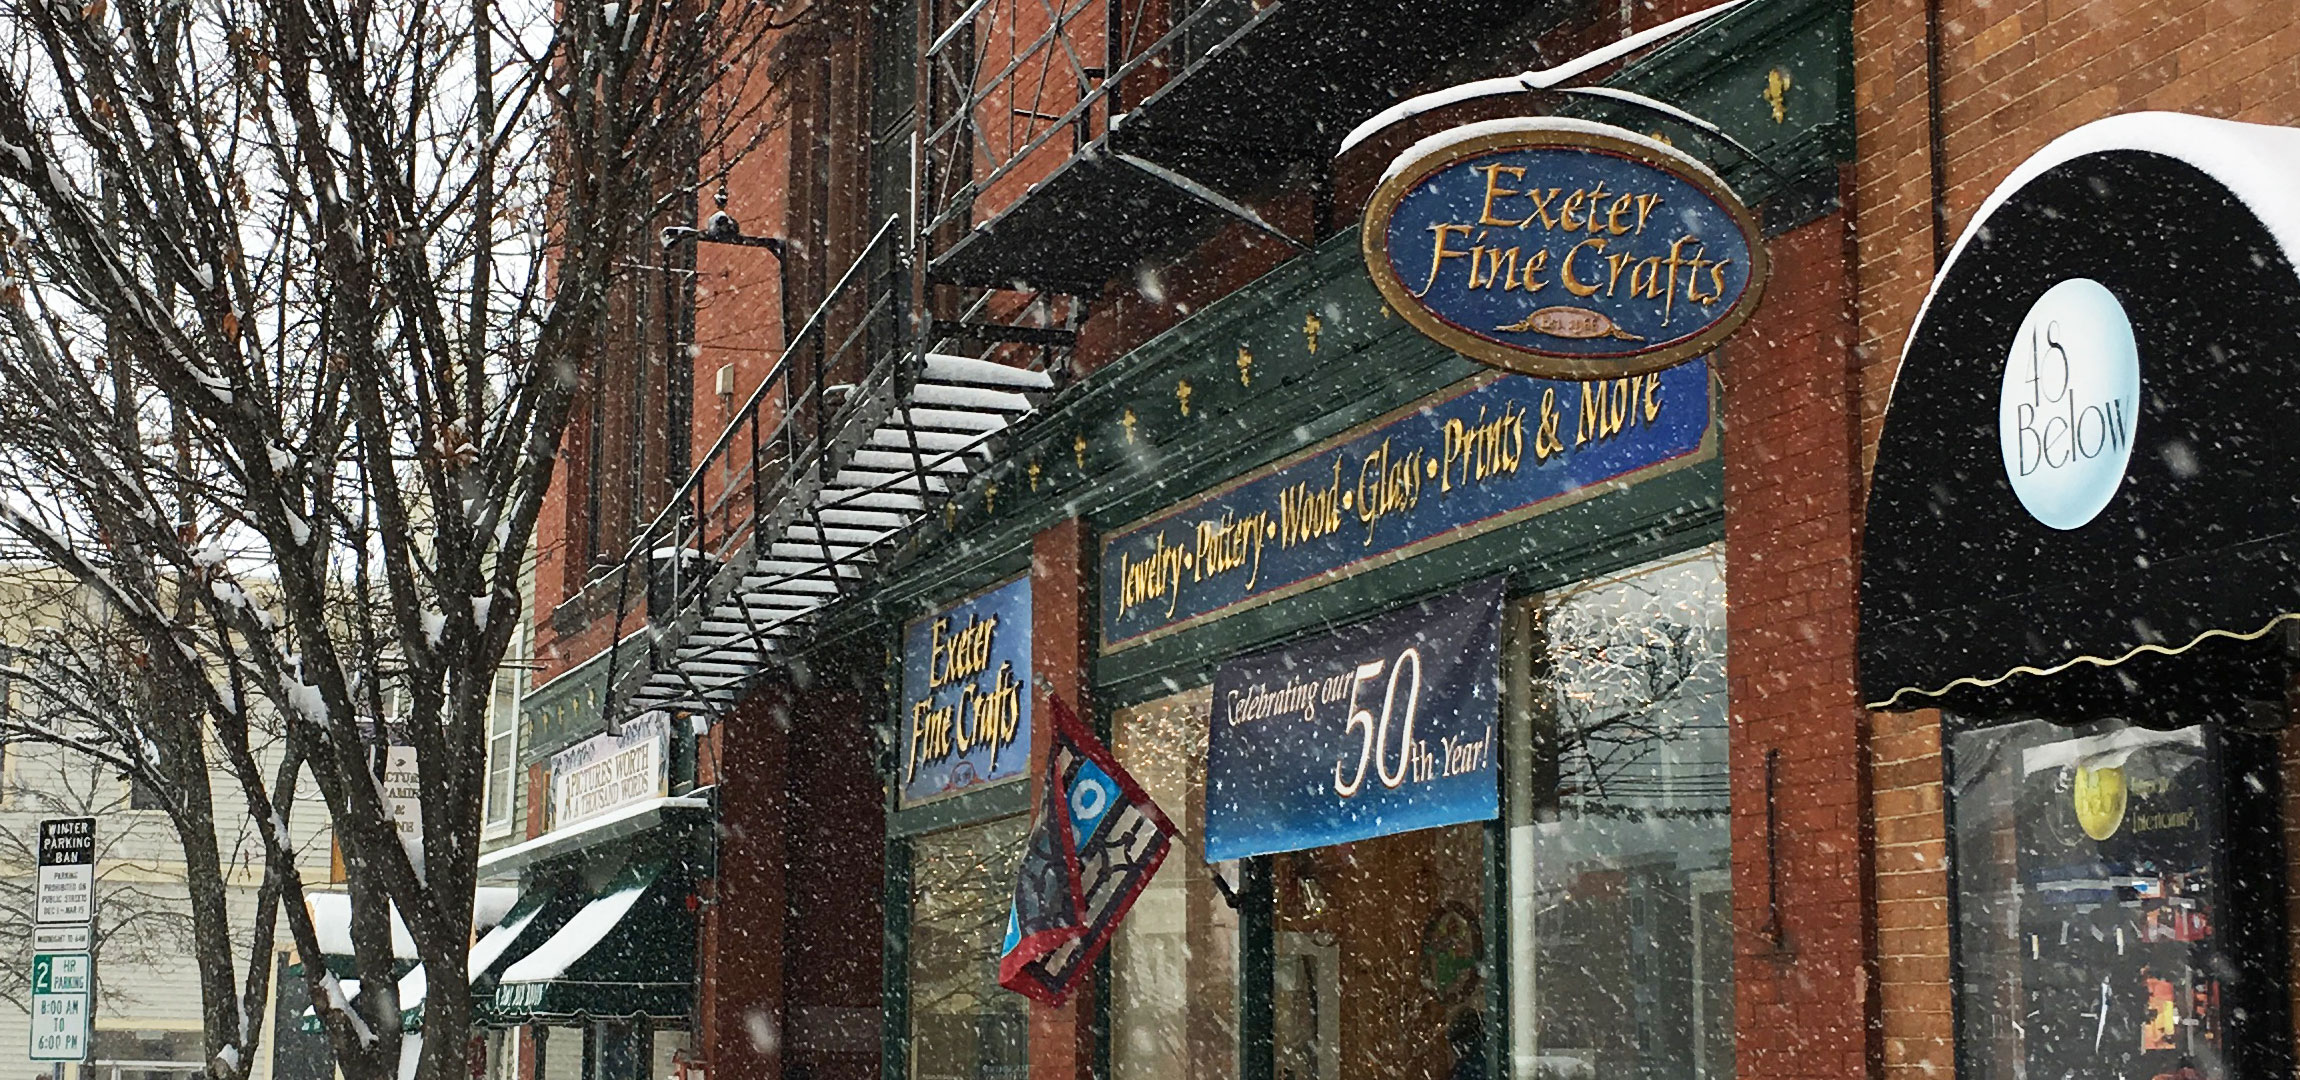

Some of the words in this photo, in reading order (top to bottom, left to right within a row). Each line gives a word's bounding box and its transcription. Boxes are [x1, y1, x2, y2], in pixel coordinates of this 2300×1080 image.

[1477, 163, 1664, 236] Exeter
[1414, 222, 1549, 298] Fine
[1562, 234, 1734, 327] Crafts
[2018, 390, 2130, 476] Below
[1116, 529, 1184, 622] Jewelry
[1195, 509, 1267, 590] Pottery
[1281, 453, 1342, 550] Wood
[1358, 437, 1424, 546] Glass
[1442, 400, 1526, 492] Prints
[1535, 388, 1563, 459] &
[1575, 373, 1663, 446] More
[930, 614, 997, 688] Exeter
[906, 696, 953, 783] Fine
[956, 661, 1020, 779] Crafts
[1227, 674, 1319, 727] Celebrating
[1322, 670, 1354, 705] our
[1441, 725, 1491, 778] Year!
[615, 742, 650, 780] WORTH
[582, 782, 619, 815] THOUSAND
[621, 770, 649, 801] WORDS
[394, 804, 406, 815] &
[43, 836, 91, 850] PARKING
[48, 822, 89, 836] WINTER
[55, 851, 78, 863] BAN
[37, 961, 49, 988] 2
[63, 959, 77, 973] HR
[53, 975, 84, 989] PARKING
[41, 1000, 63, 1015] 8:00
[65, 1000, 79, 1015] AM
[53, 1017, 65, 1032] TO
[38, 1035, 61, 1050] 6:00
[65, 1035, 78, 1050] PM
